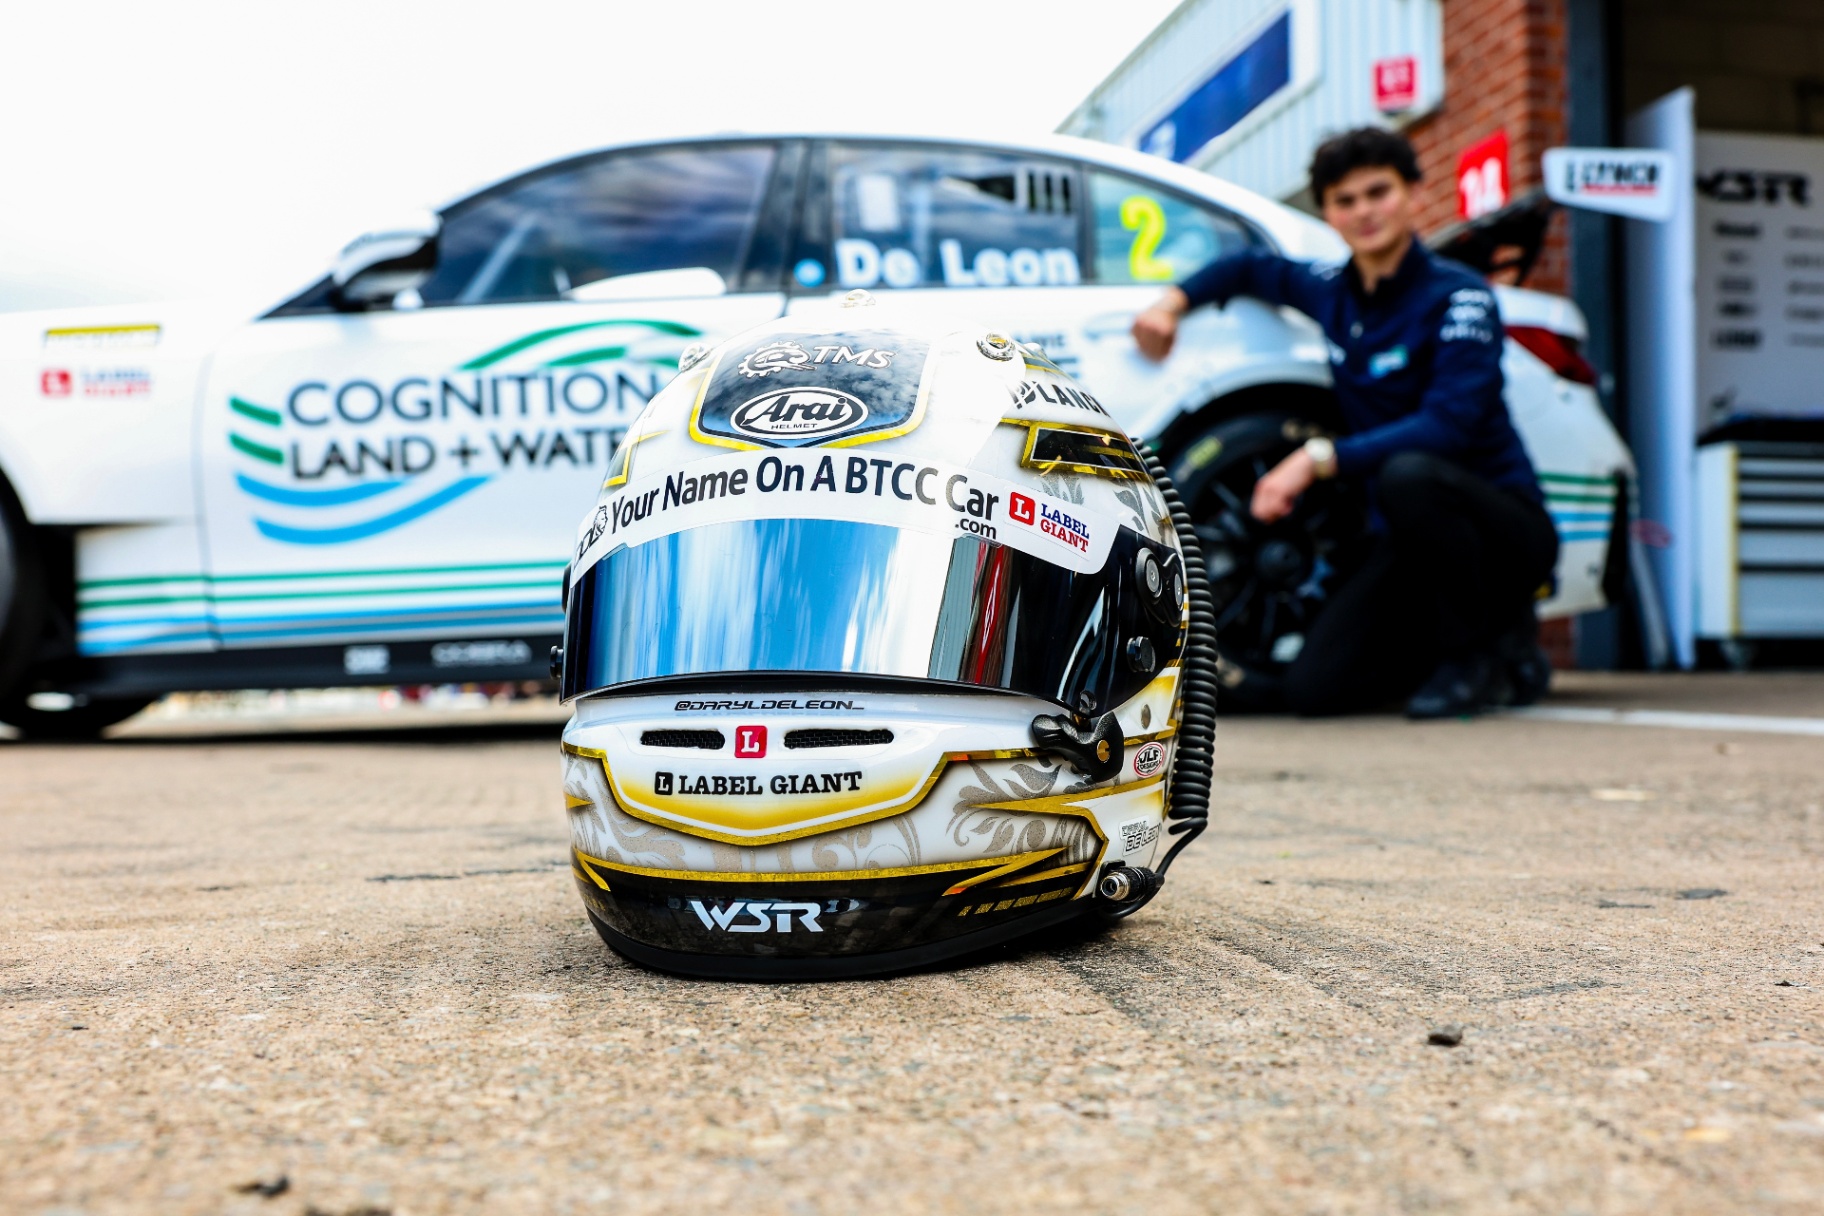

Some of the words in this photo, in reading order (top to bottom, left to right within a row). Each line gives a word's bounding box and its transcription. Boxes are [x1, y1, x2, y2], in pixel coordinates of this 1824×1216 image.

[1120, 196, 1174, 281] 2
[836, 238, 921, 288] De
[939, 238, 1082, 287] Leon
[813, 345, 897, 369] TMS
[288, 372, 659, 426] COGNITION
[740, 395, 848, 426] Arai
[292, 435, 437, 480] LAND
[612, 488, 660, 534] Your
[662, 471, 749, 511] Name
[756, 456, 805, 493] On
[810, 455, 837, 493] A
[845, 456, 939, 506] BTCC
[946, 474, 999, 521] Car
[1014, 497, 1030, 520] L
[955, 518, 997, 540] .com
[1040, 519, 1089, 553] GIANT
[1041, 503, 1090, 539] LABEL
[741, 731, 760, 753] L
[678, 775, 763, 795] LABEL
[770, 771, 863, 795] GIANT
[690, 900, 824, 933] WSR
